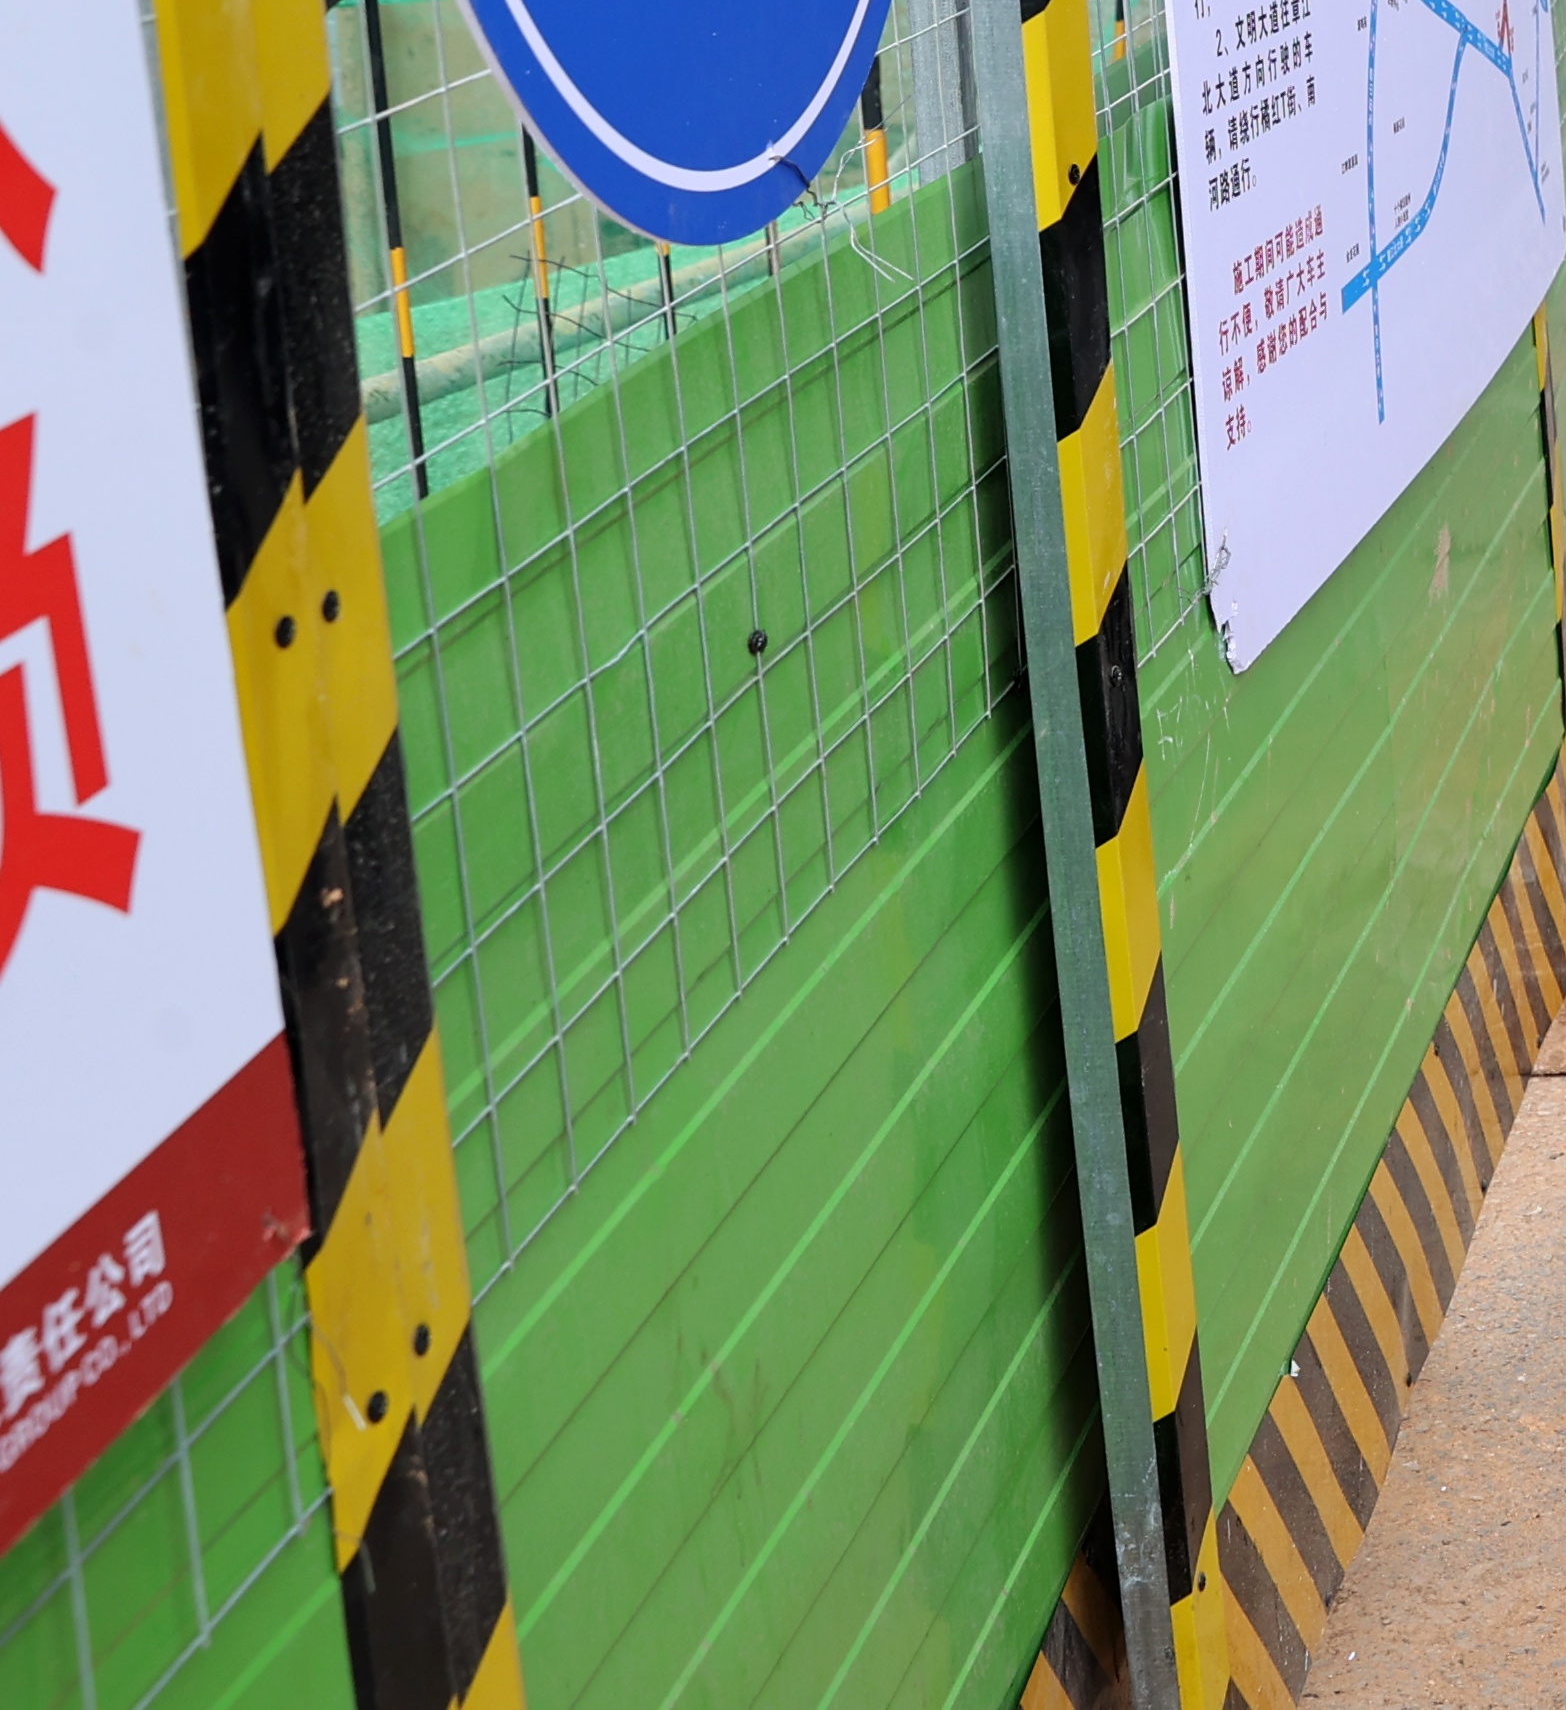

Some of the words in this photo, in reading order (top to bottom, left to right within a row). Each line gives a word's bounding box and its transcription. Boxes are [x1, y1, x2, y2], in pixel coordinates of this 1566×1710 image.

[1201, 30, 1314, 117] 北大道方向行驶的车
[1232, 203, 1324, 296] 施工期间可能造成通
